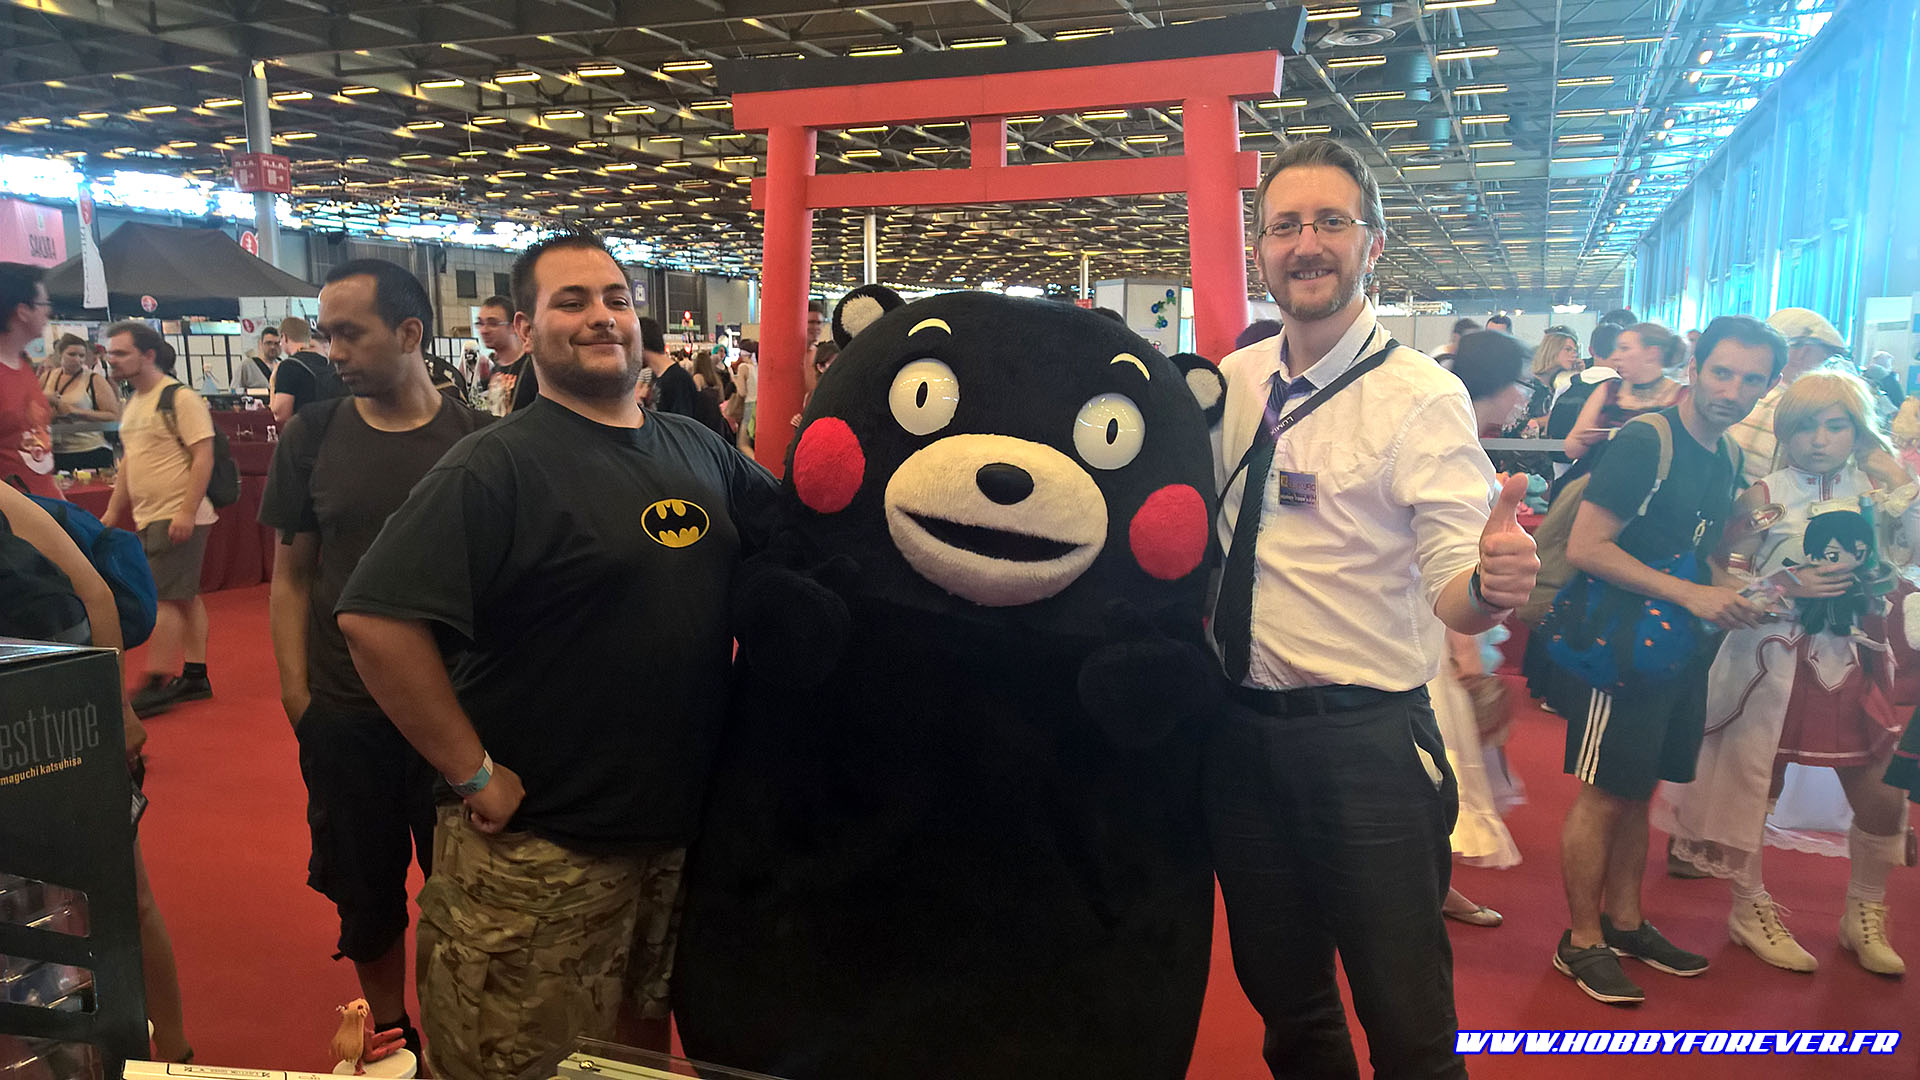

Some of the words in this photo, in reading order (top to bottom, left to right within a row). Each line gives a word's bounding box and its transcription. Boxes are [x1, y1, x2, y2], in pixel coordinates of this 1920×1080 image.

[1270, 416, 1293, 435] LUMIX
[41, 702, 99, 760] type
[0, 765, 39, 786] maguchi
[40, 756, 82, 775] katsuhisa
